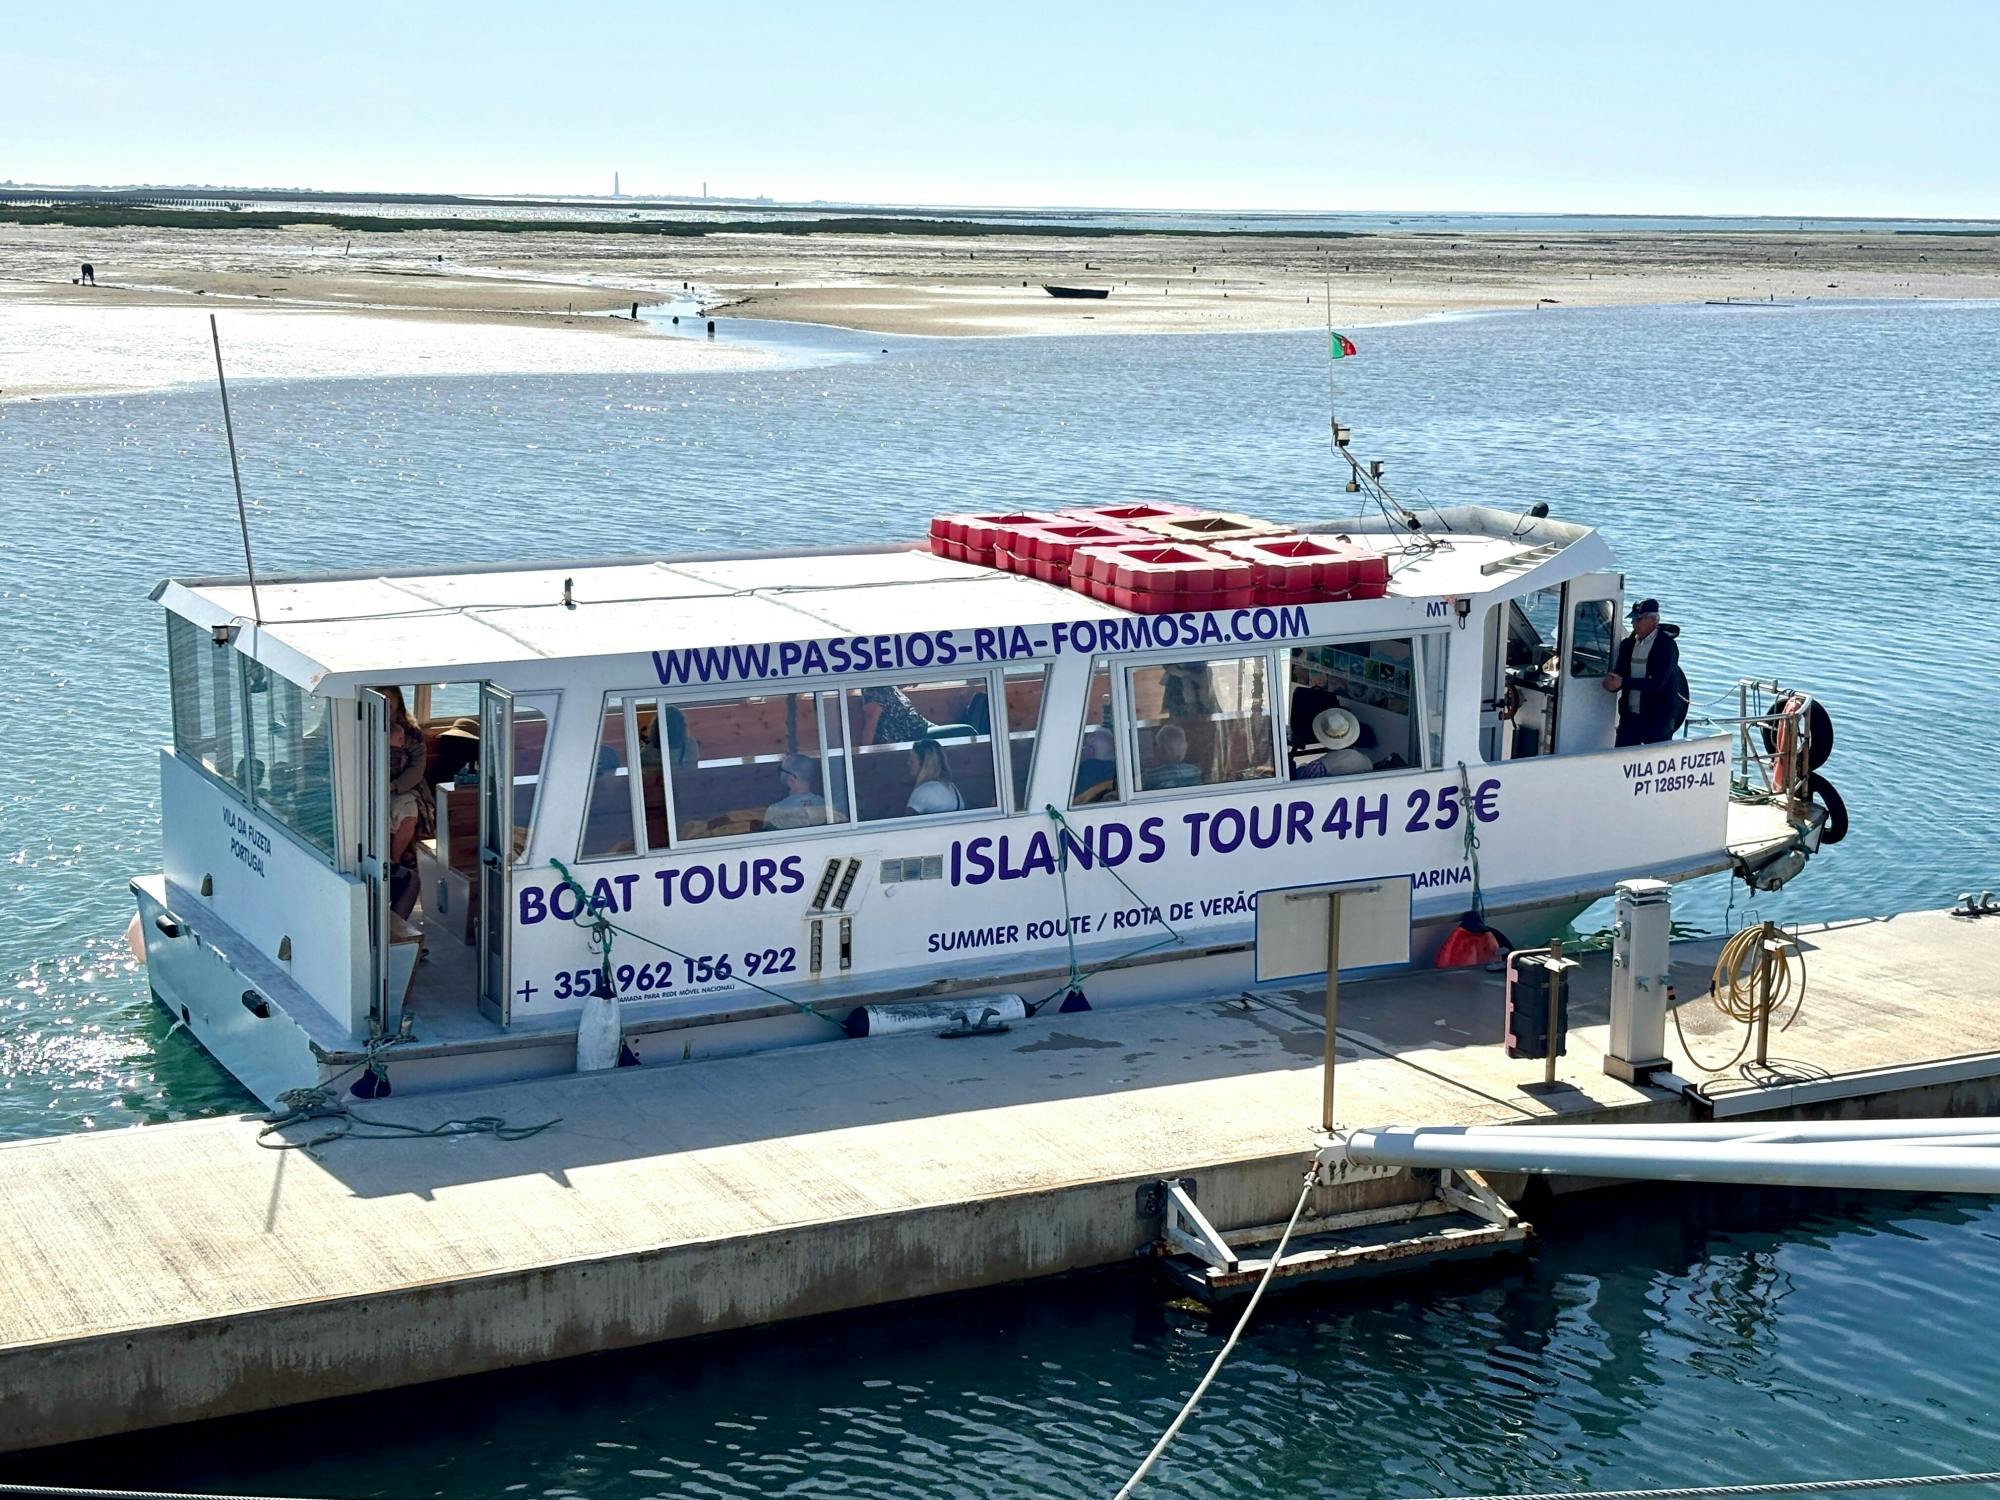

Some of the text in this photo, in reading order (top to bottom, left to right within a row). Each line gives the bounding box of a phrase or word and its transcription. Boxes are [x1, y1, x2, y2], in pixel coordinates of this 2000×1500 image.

[1427, 601, 1448, 617] MT
[652, 606, 1310, 685] WWW.PASSEIOS-RIA-FORMOSA.COM
[1623, 750, 1726, 778] VILA DA FUZETA
[1634, 772, 1715, 796] PT 128519-AL
[223, 806, 271, 856] VILA DA FUZETA
[950, 817, 1166, 887] ISLANDS
[1183, 801, 1314, 857] TOUR
[231, 837, 264, 878] PORTUGAL
[520, 856, 805, 925] BOAT TOURS
[928, 925, 1018, 952] SUMMER
[1027, 915, 1091, 941] ROUTE
[1114, 906, 1163, 929] ROTA
[1170, 902, 1193, 921] DE
[617, 961, 673, 992] 962
[684, 954, 732, 983] 156
[744, 947, 796, 977] 922
